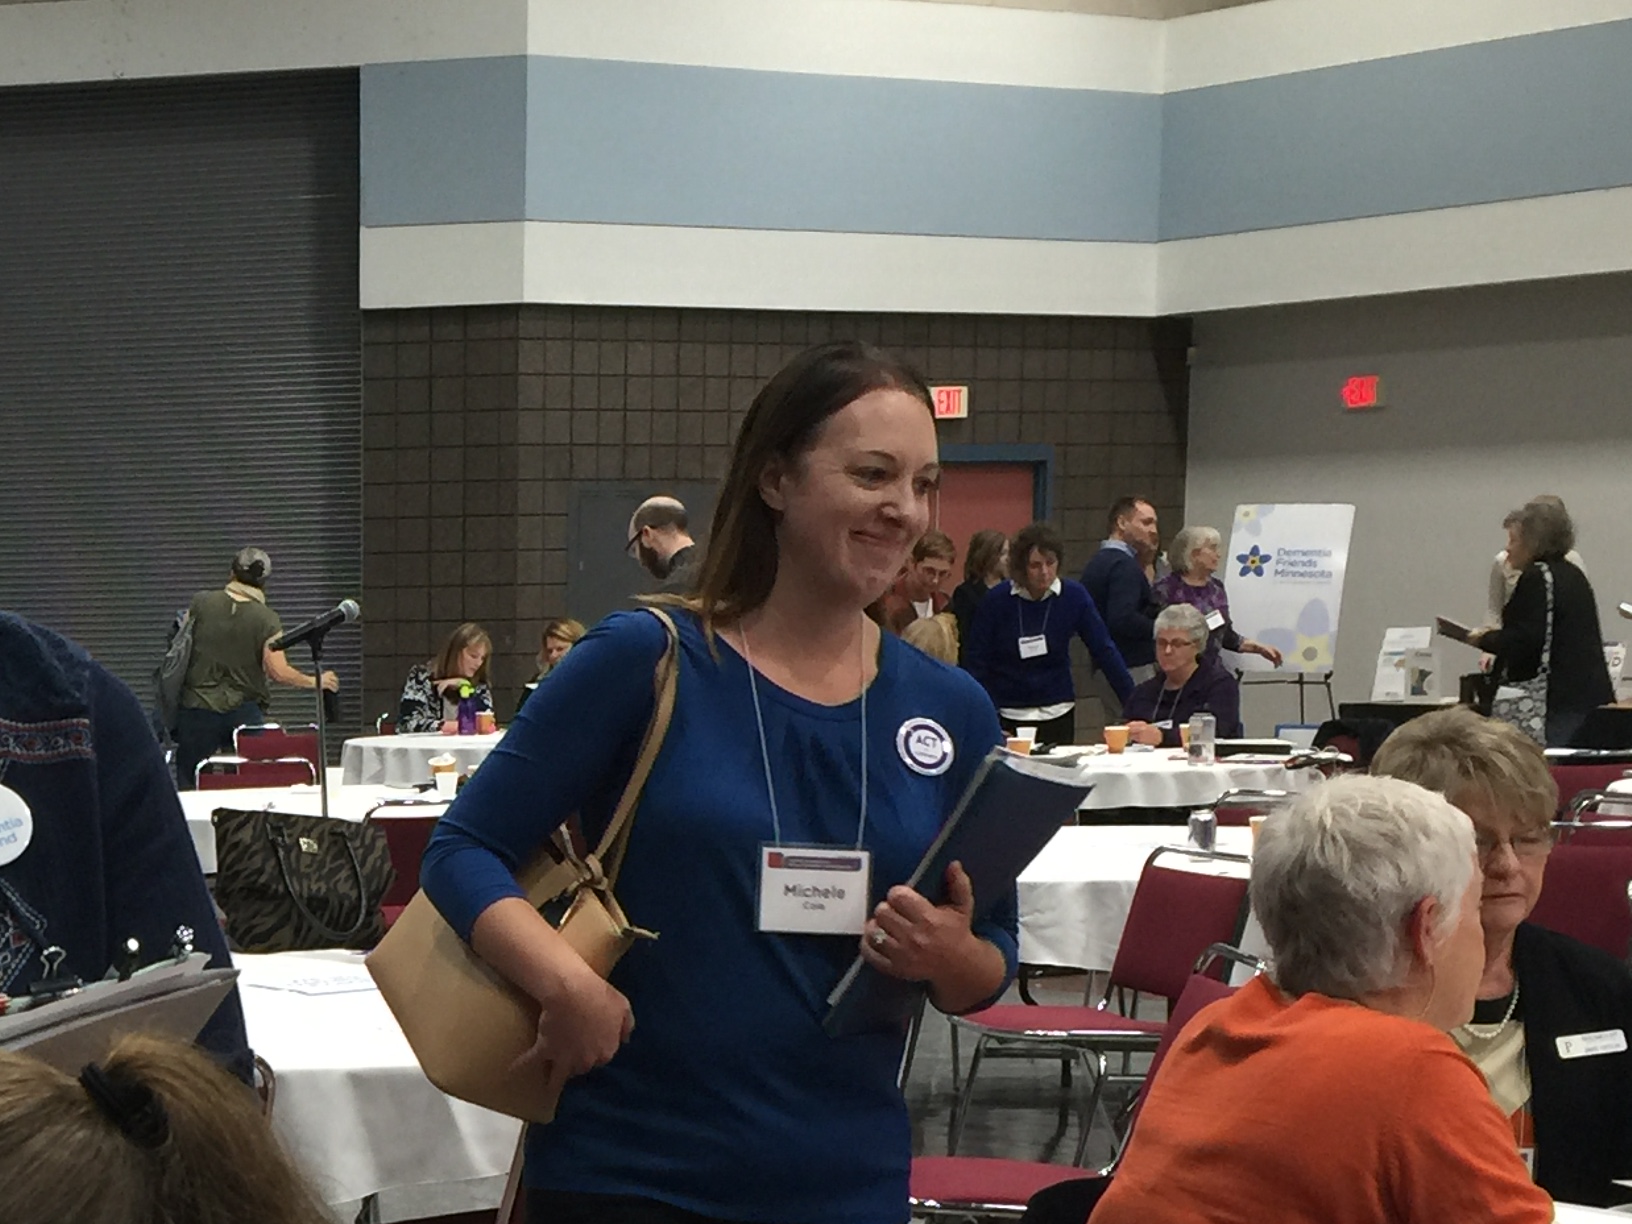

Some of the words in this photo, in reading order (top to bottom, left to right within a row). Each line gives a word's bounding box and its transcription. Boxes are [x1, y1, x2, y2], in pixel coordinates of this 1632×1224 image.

[937, 389, 963, 416] EXIT
[1276, 548, 1332, 557] Dementia
[1275, 559, 1318, 568] Friends
[1274, 569, 1333, 578] Minnesota
[783, 884, 846, 900] Michele
